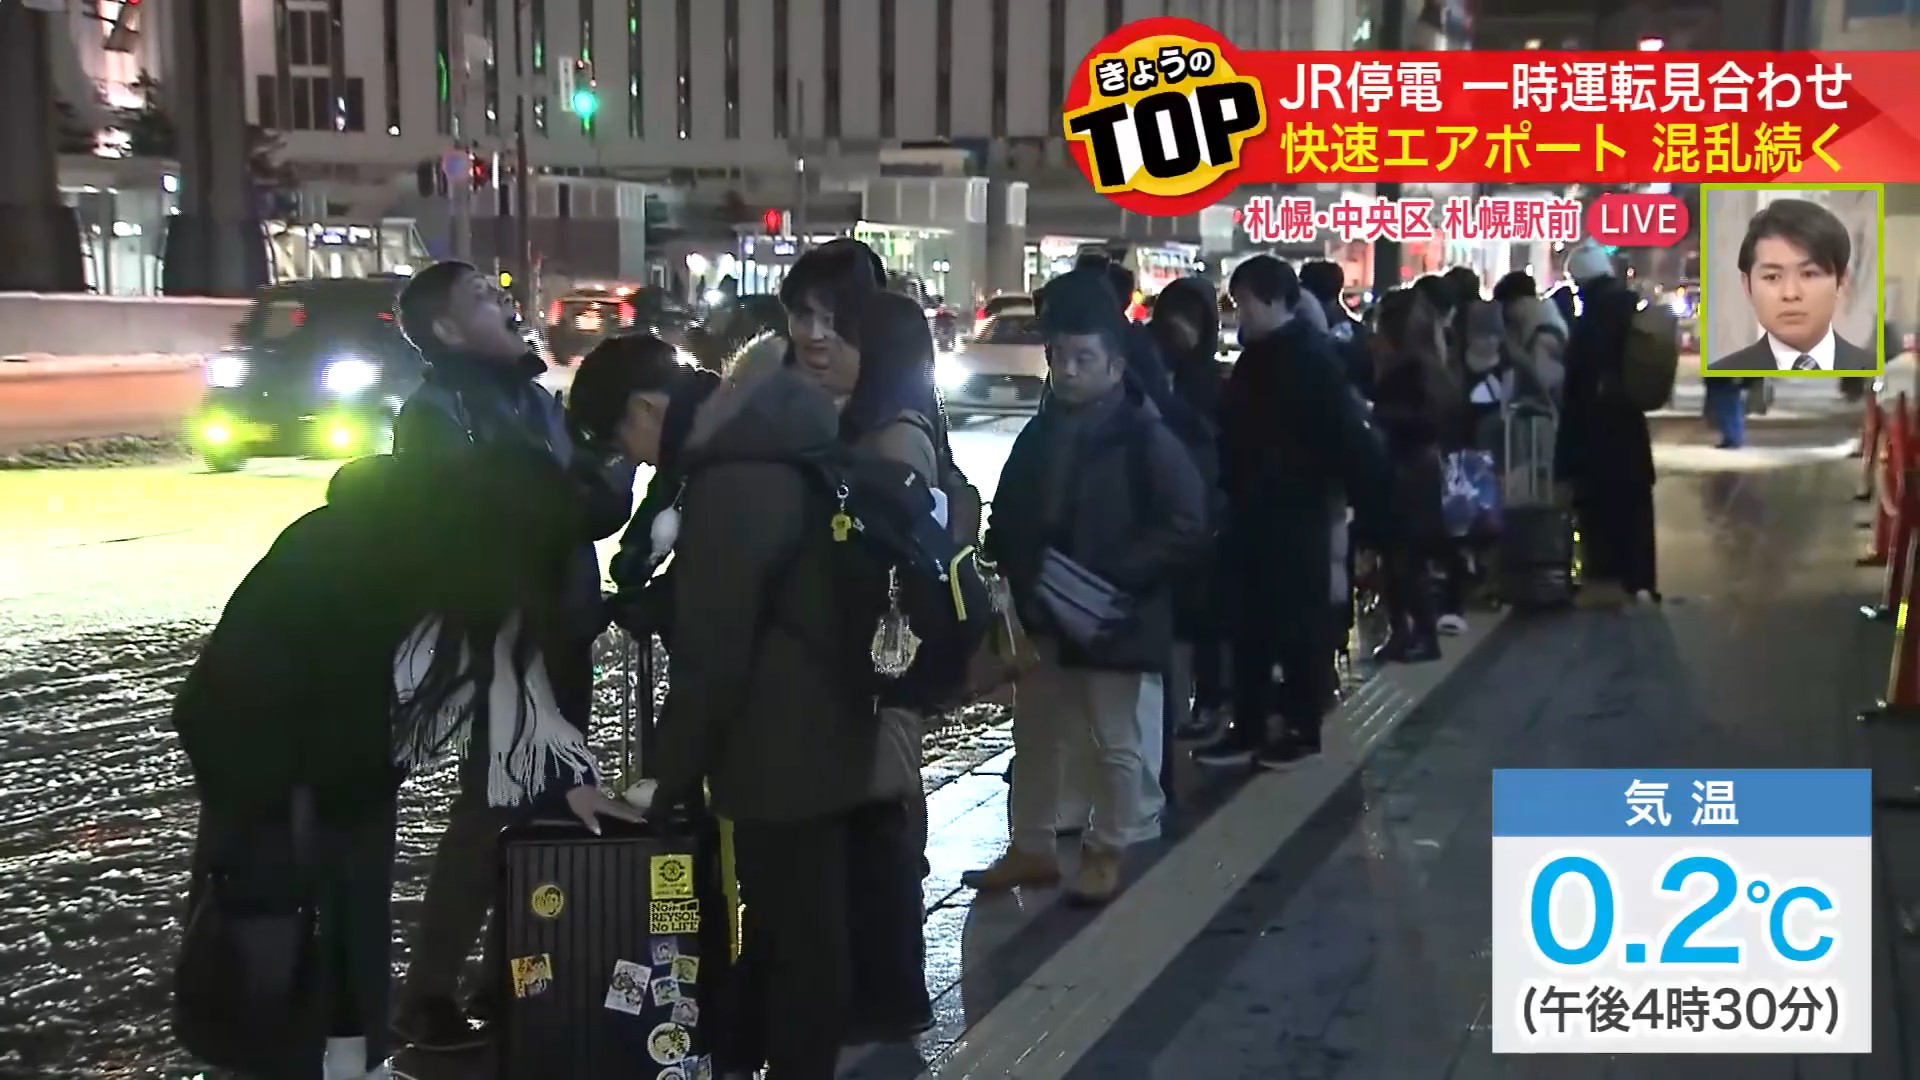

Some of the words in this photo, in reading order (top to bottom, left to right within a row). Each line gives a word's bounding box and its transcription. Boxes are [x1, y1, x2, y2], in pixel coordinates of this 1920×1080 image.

[651, 912, 698, 922] REYSOL
[651, 922, 668, 932] No
[671, 921, 697, 931] LIFE
